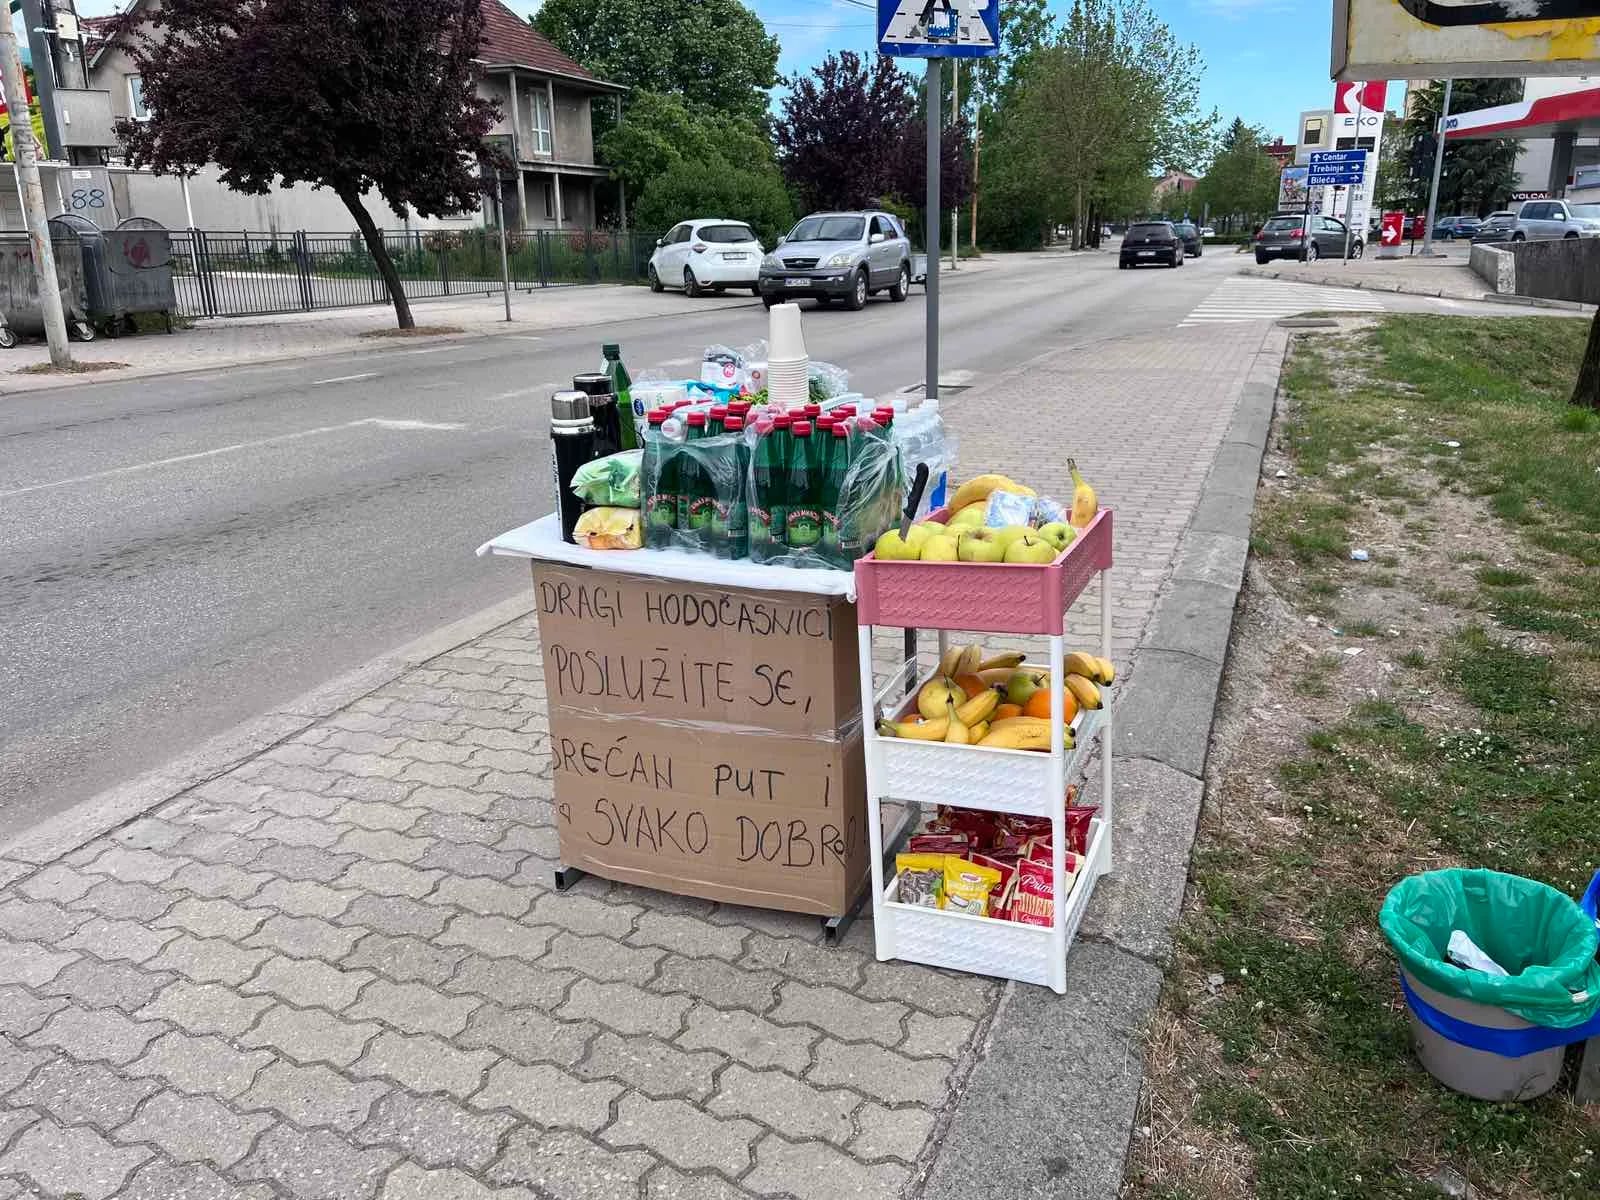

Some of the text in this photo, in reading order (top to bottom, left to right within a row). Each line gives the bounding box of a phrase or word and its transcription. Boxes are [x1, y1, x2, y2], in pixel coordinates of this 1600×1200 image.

[1344, 116, 1378, 126] EKO
[1322, 152, 1348, 161] Centar
[1312, 164, 1344, 174] Trebinje
[71, 189, 105, 209] 88
[645, 594, 833, 640] HODOČASNICI
[714, 764, 785, 800] PUT
[586, 798, 708, 854] SVAKO
